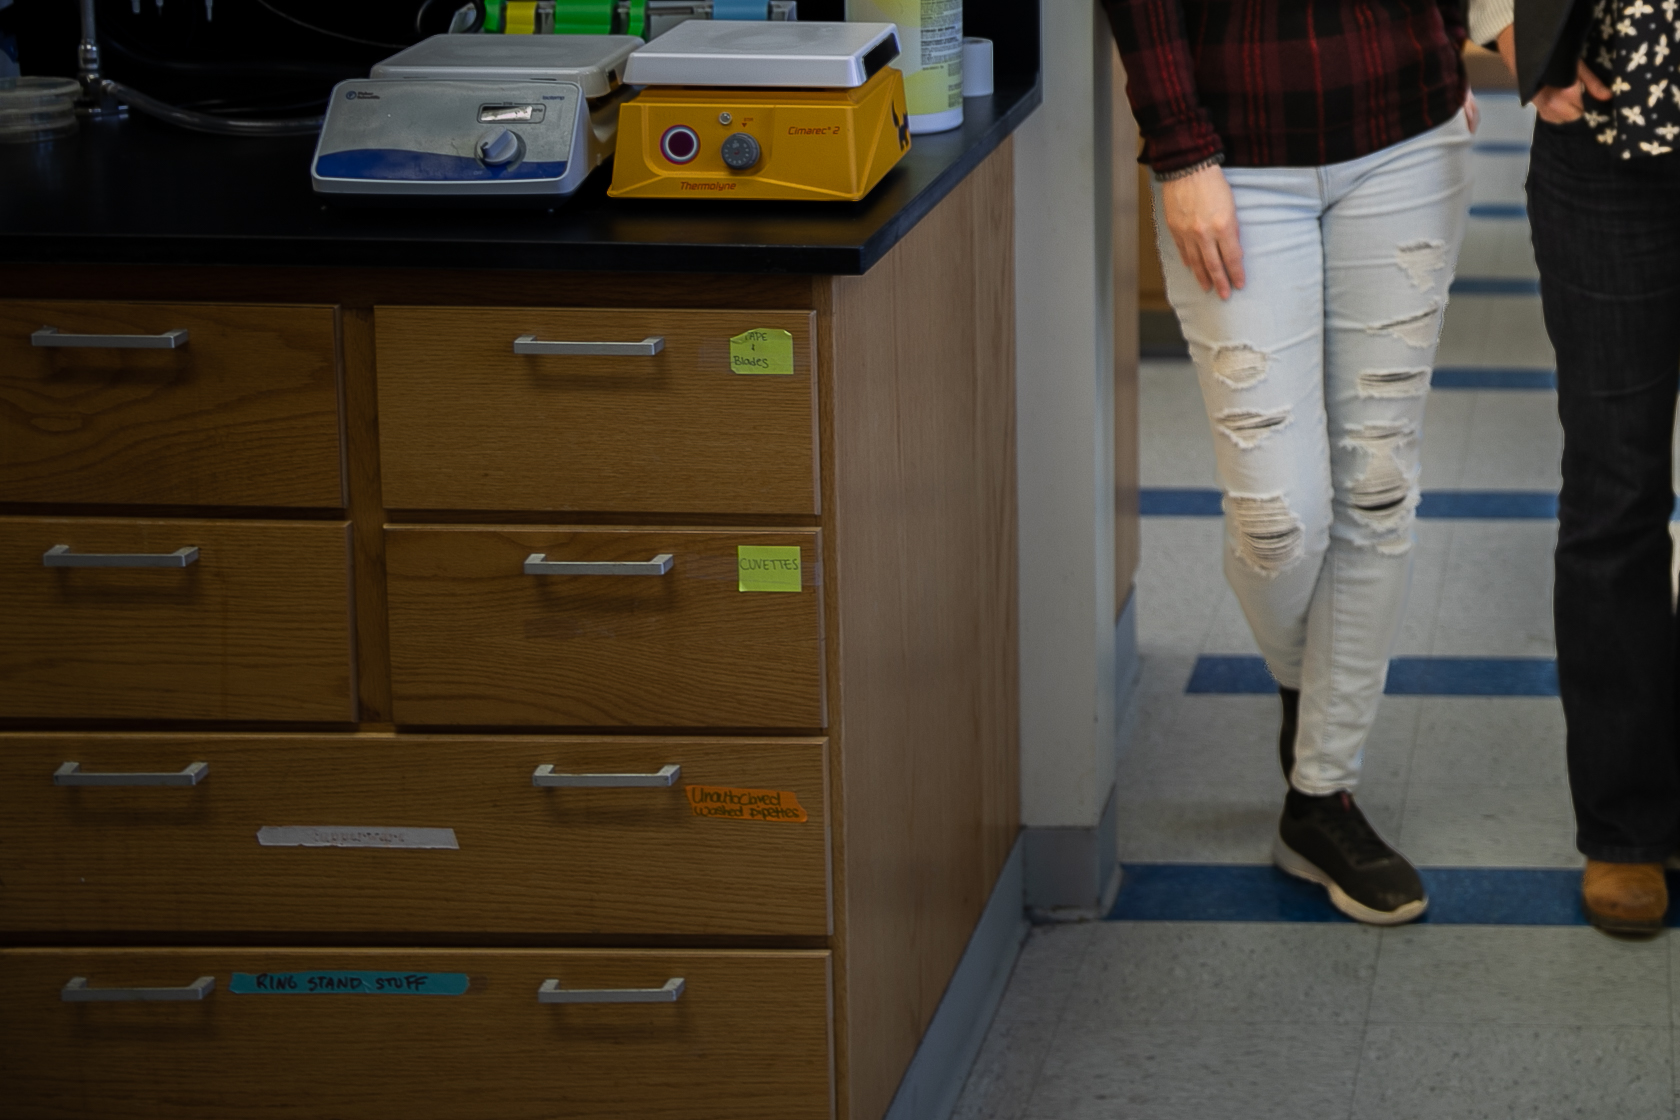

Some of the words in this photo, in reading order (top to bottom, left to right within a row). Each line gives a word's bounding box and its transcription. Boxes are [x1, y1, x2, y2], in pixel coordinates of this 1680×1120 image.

[833, 126, 840, 135] 2
[680, 181, 736, 192] Thermolyne
[733, 355, 769, 369] Blades
[739, 557, 799, 571] CUVETTES
[255, 973, 297, 991] RING
[306, 975, 362, 992] STAND
[375, 975, 428, 992] STUFF
